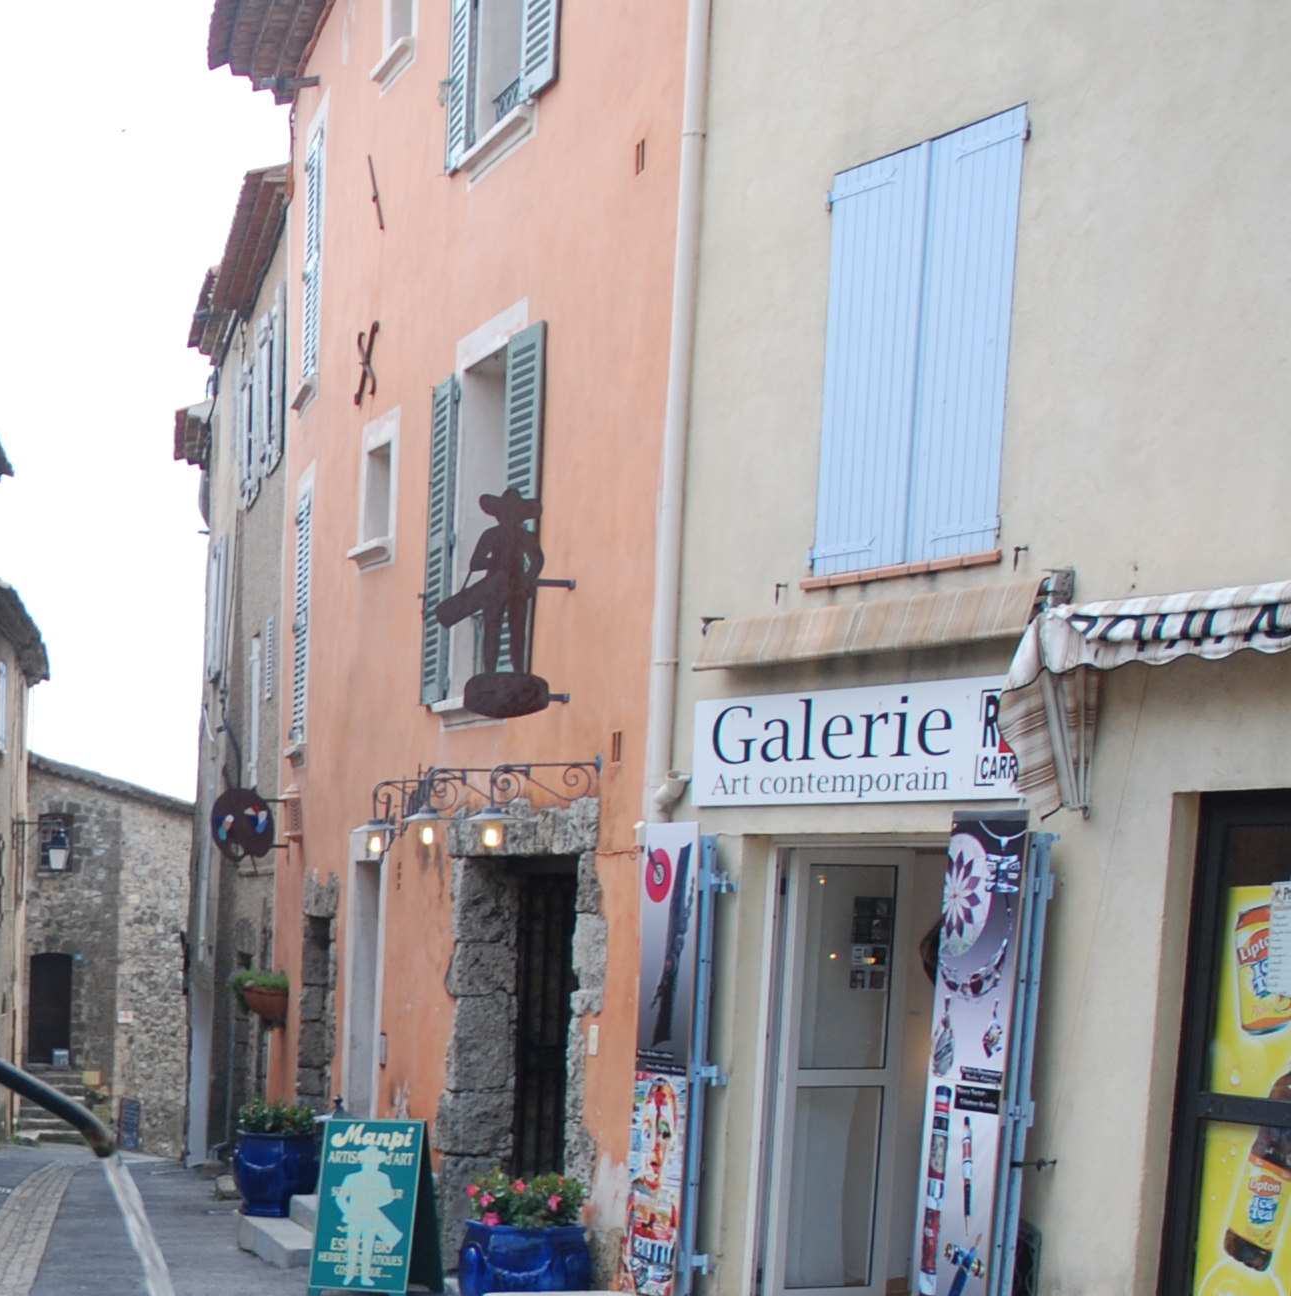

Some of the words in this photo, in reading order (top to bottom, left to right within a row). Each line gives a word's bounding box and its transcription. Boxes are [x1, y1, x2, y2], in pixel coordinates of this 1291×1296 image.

[712, 696, 952, 765] Galerie
[981, 756, 1017, 779] CARR
[711, 772, 751, 795] Art
[760, 766, 948, 798] contemporain
[1238, 935, 1269, 961] Lipto
[331, 1123, 415, 1150] Manpi
[1250, 1178, 1280, 1192] Lipton
[1251, 1208, 1273, 1220] Tea
[1253, 1196, 1274, 1208] Ice
